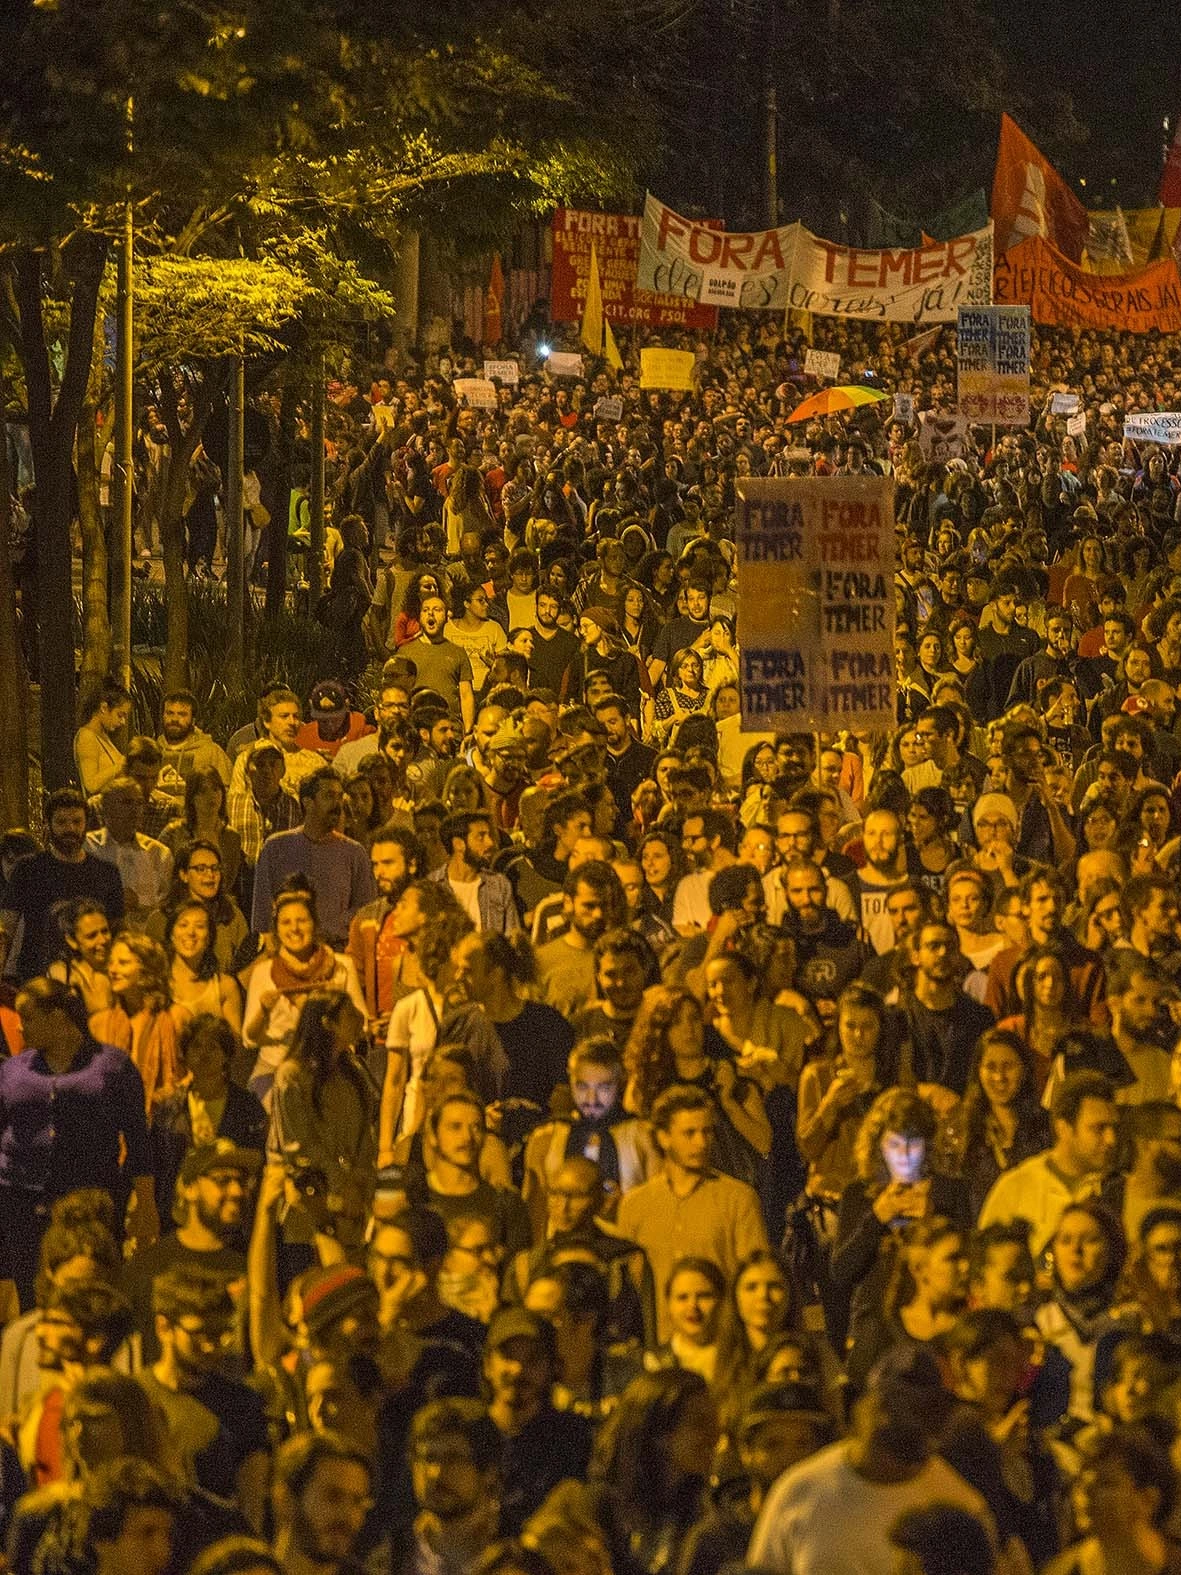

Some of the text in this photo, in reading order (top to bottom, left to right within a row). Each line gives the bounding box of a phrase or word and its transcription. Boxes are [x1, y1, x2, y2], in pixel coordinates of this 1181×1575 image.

[565, 209, 619, 237] FORA
[657, 207, 785, 270] FORA
[811, 235, 977, 288] TEMER
[660, 309, 687, 322] PSOL
[913, 280, 963, 321] já!
[961, 312, 990, 327] FORA
[999, 315, 1026, 329] FORA
[960, 343, 1026, 359] FORA FORA
[743, 500, 882, 529] FORA FORA
[741, 531, 881, 562] TEMER TEMER
[825, 569, 888, 600] FORA
[824, 603, 886, 634] TEMER
[743, 650, 892, 681] FORA FORA
[743, 683, 892, 714] TEMER TEMER
